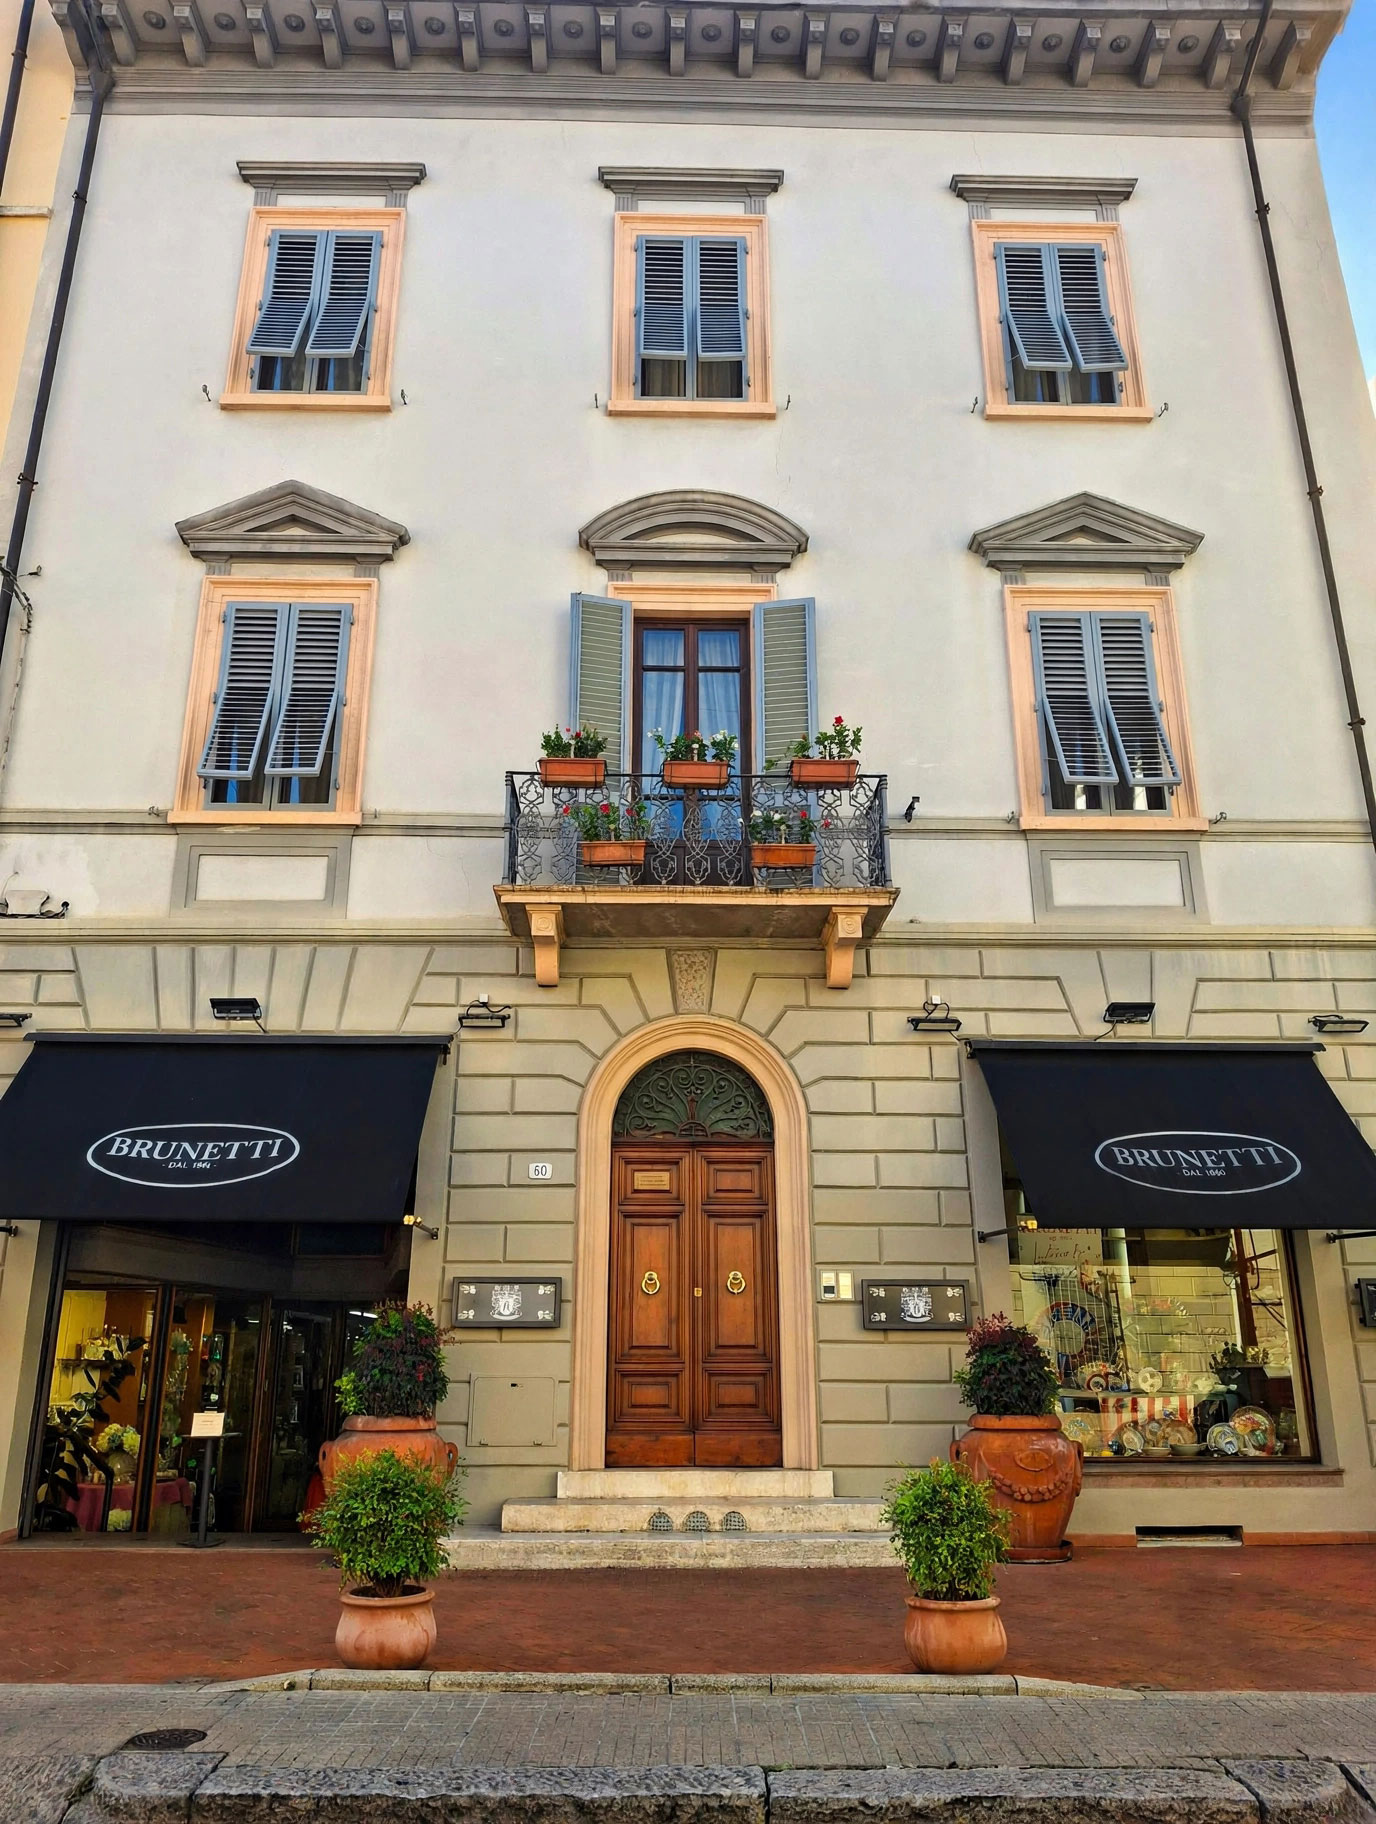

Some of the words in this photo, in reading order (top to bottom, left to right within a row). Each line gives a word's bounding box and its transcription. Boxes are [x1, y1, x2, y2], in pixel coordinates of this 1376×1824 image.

[107, 1137, 284, 1160] BRUNETTI
[168, 1161, 188, 1169] DAL
[1111, 1147, 1283, 1167] BRUNETTI
[533, 1165, 547, 1177] 60
